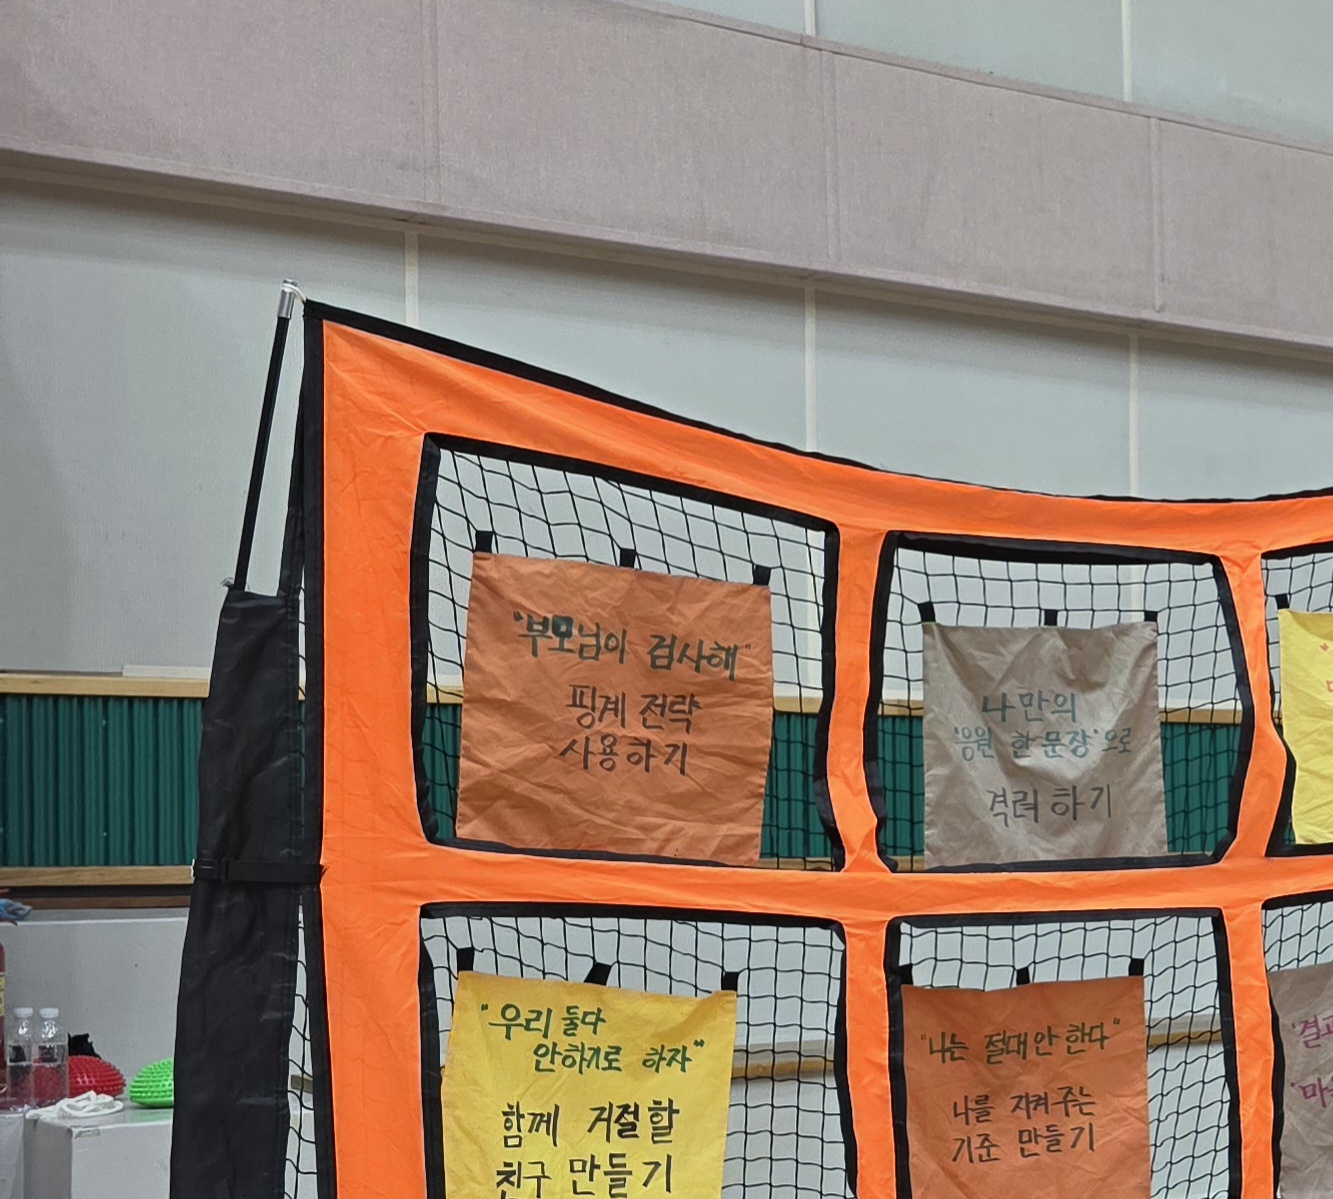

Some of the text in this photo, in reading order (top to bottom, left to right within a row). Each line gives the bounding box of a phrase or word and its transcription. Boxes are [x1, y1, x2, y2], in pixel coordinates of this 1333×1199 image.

[566, 684, 702, 735] 핑계 전략
[982, 689, 1077, 723] 나만의
[558, 733, 689, 778] 사용하기
[986, 784, 1112, 828] 격려하기
[501, 1097, 680, 1148] 함께 거절할
[953, 1094, 996, 1126] 나를
[952, 1122, 1096, 1164] 기준 만들기
[569, 1152, 673, 1198] 만들기
